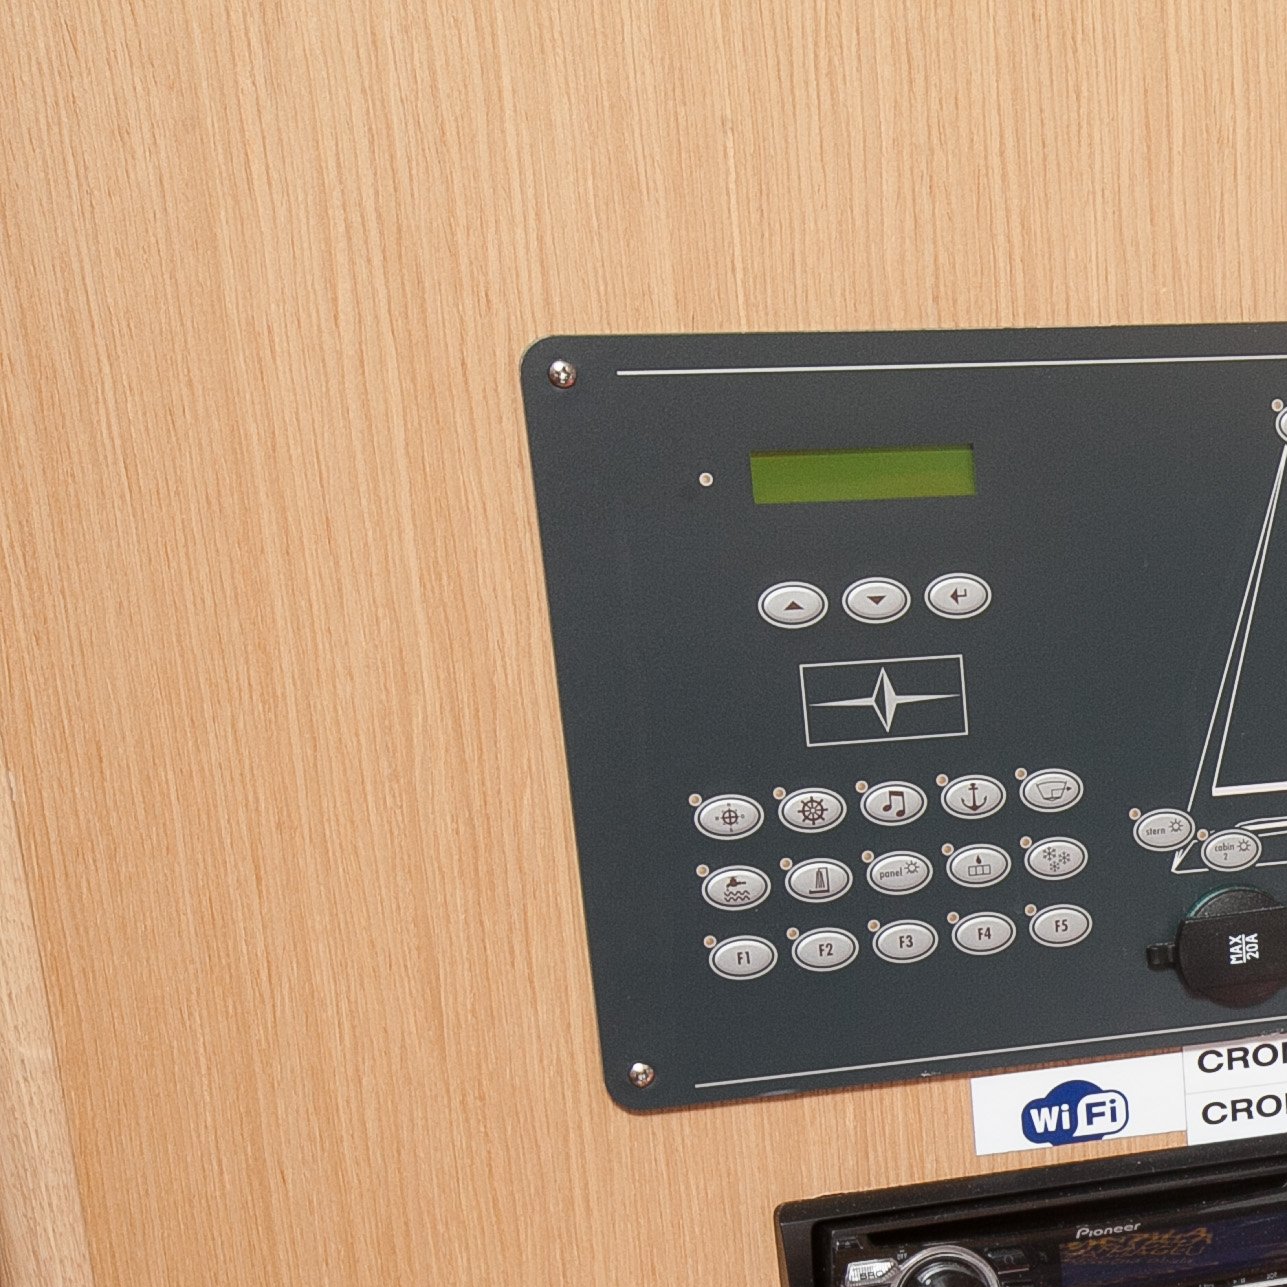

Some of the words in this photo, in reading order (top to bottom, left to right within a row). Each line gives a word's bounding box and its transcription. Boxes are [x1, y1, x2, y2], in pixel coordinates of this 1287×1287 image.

[1145, 826, 1166, 836] stern
[1213, 843, 1236, 853] cabin
[878, 867, 903, 881] panel
[1054, 918, 1069, 933] F5
[977, 926, 993, 941] F4
[898, 935, 914, 949] F3
[1229, 934, 1246, 965] MAX
[1246, 932, 1260, 960] 20A
[736, 951, 751, 965] F1
[818, 943, 834, 958] F2
[1075, 1222, 1142, 1239] Pioneer
